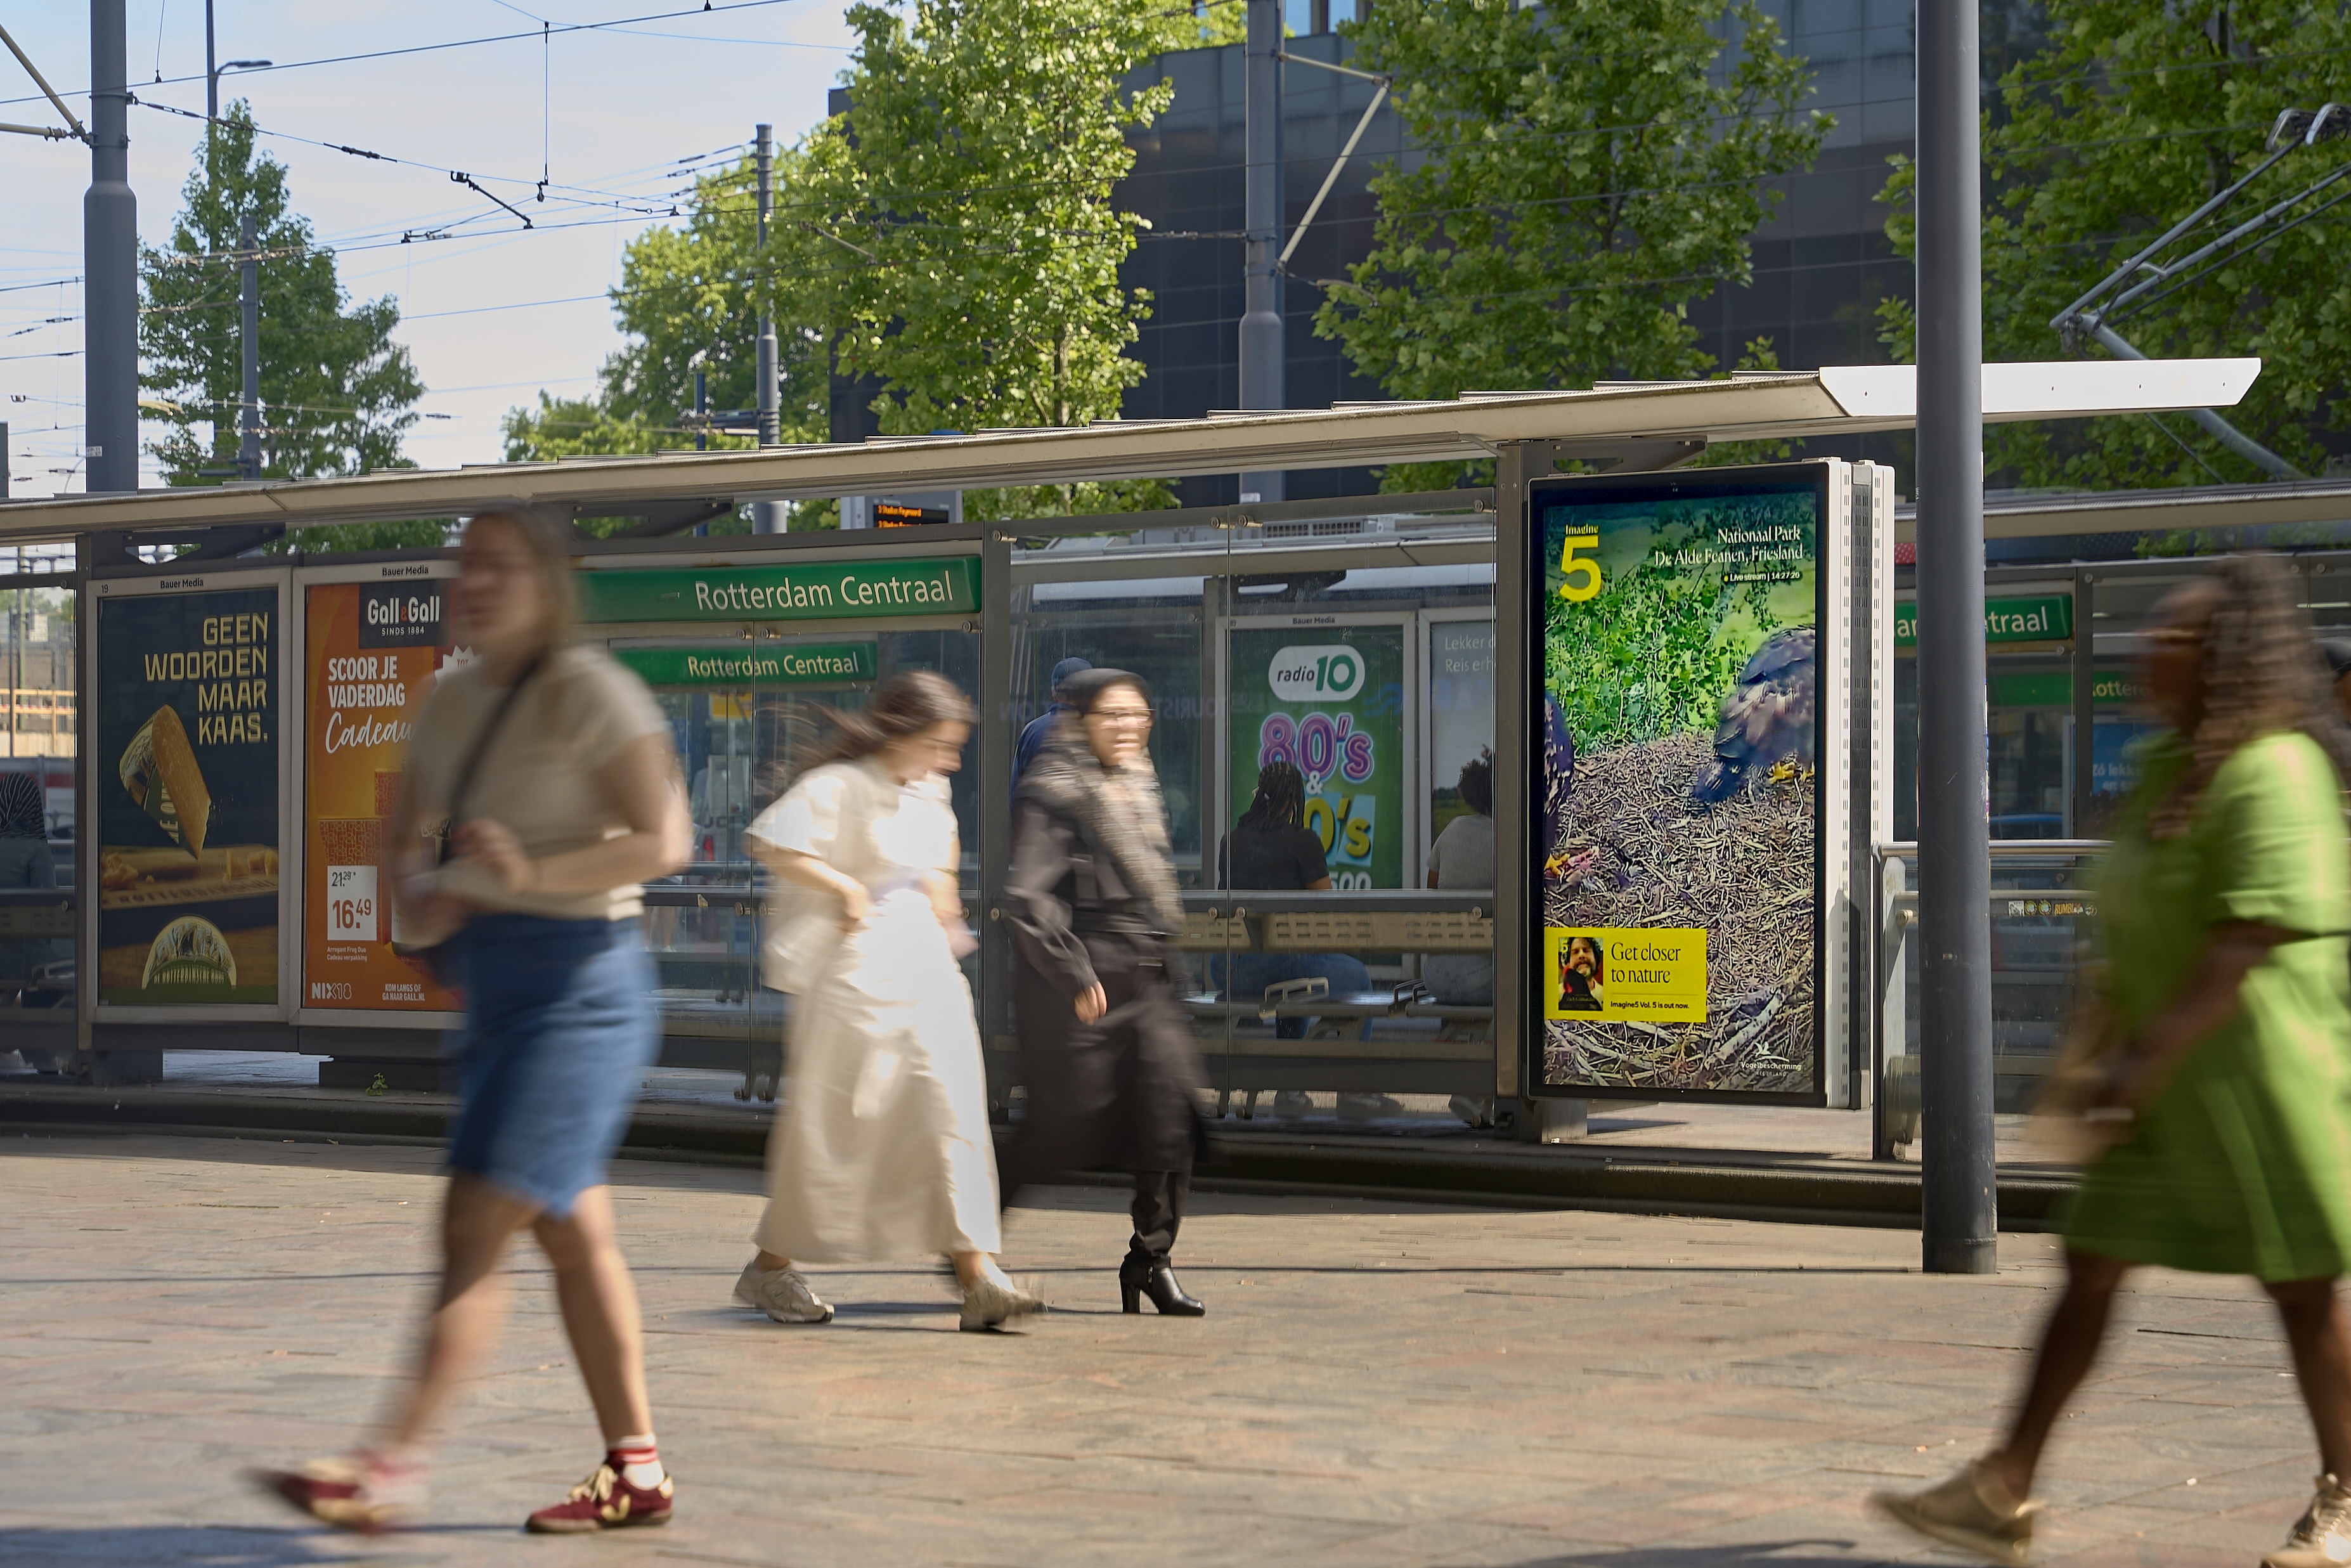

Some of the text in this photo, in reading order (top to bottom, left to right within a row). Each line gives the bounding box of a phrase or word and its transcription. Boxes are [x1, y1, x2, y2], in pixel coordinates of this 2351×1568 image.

[1565, 524, 1598, 535] Imagine
[1717, 524, 1801, 545] Nationaal Park
[1655, 543, 1803, 566] De Alde Feanen, Friesland
[382, 565, 429, 577] Bauer Media
[1559, 535, 1602, 602] 5
[101, 585, 108, 593] 19
[160, 578, 204, 589] Bauer Media
[695, 570, 954, 611] Rotterdam Centraal
[203, 611, 269, 647] GEEN
[381, 625, 424, 637] SINDS 1884
[1985, 606, 2049, 633] traal
[1445, 635, 1486, 651] Lekker
[145, 644, 268, 682] WOORDEN
[328, 655, 398, 682] SCOOR JE
[687, 651, 859, 678] Rotterdam Centraal
[1276, 654, 1356, 692] radio 10
[1446, 657, 1470, 672] Reis
[198, 678, 267, 713] MAAR
[328, 682, 406, 709] VADERDAG
[198, 711, 268, 746] KAAS.
[1259, 712, 1374, 782] 80's
[1306, 770, 1323, 794] &
[1304, 797, 1371, 858] 0's
[332, 898, 372, 929] 16.49
[1611, 942, 1681, 961] Get closer
[385, 983, 422, 992] KOM LANGS OF
[1611, 969, 1671, 983] to nature
[311, 982, 353, 1001] NIX18
[382, 992, 425, 1001] GA NAAR GALL.NL
[1610, 1001, 1638, 1009] Imagine5
[1740, 1061, 1802, 1072] Vogelbescherming
